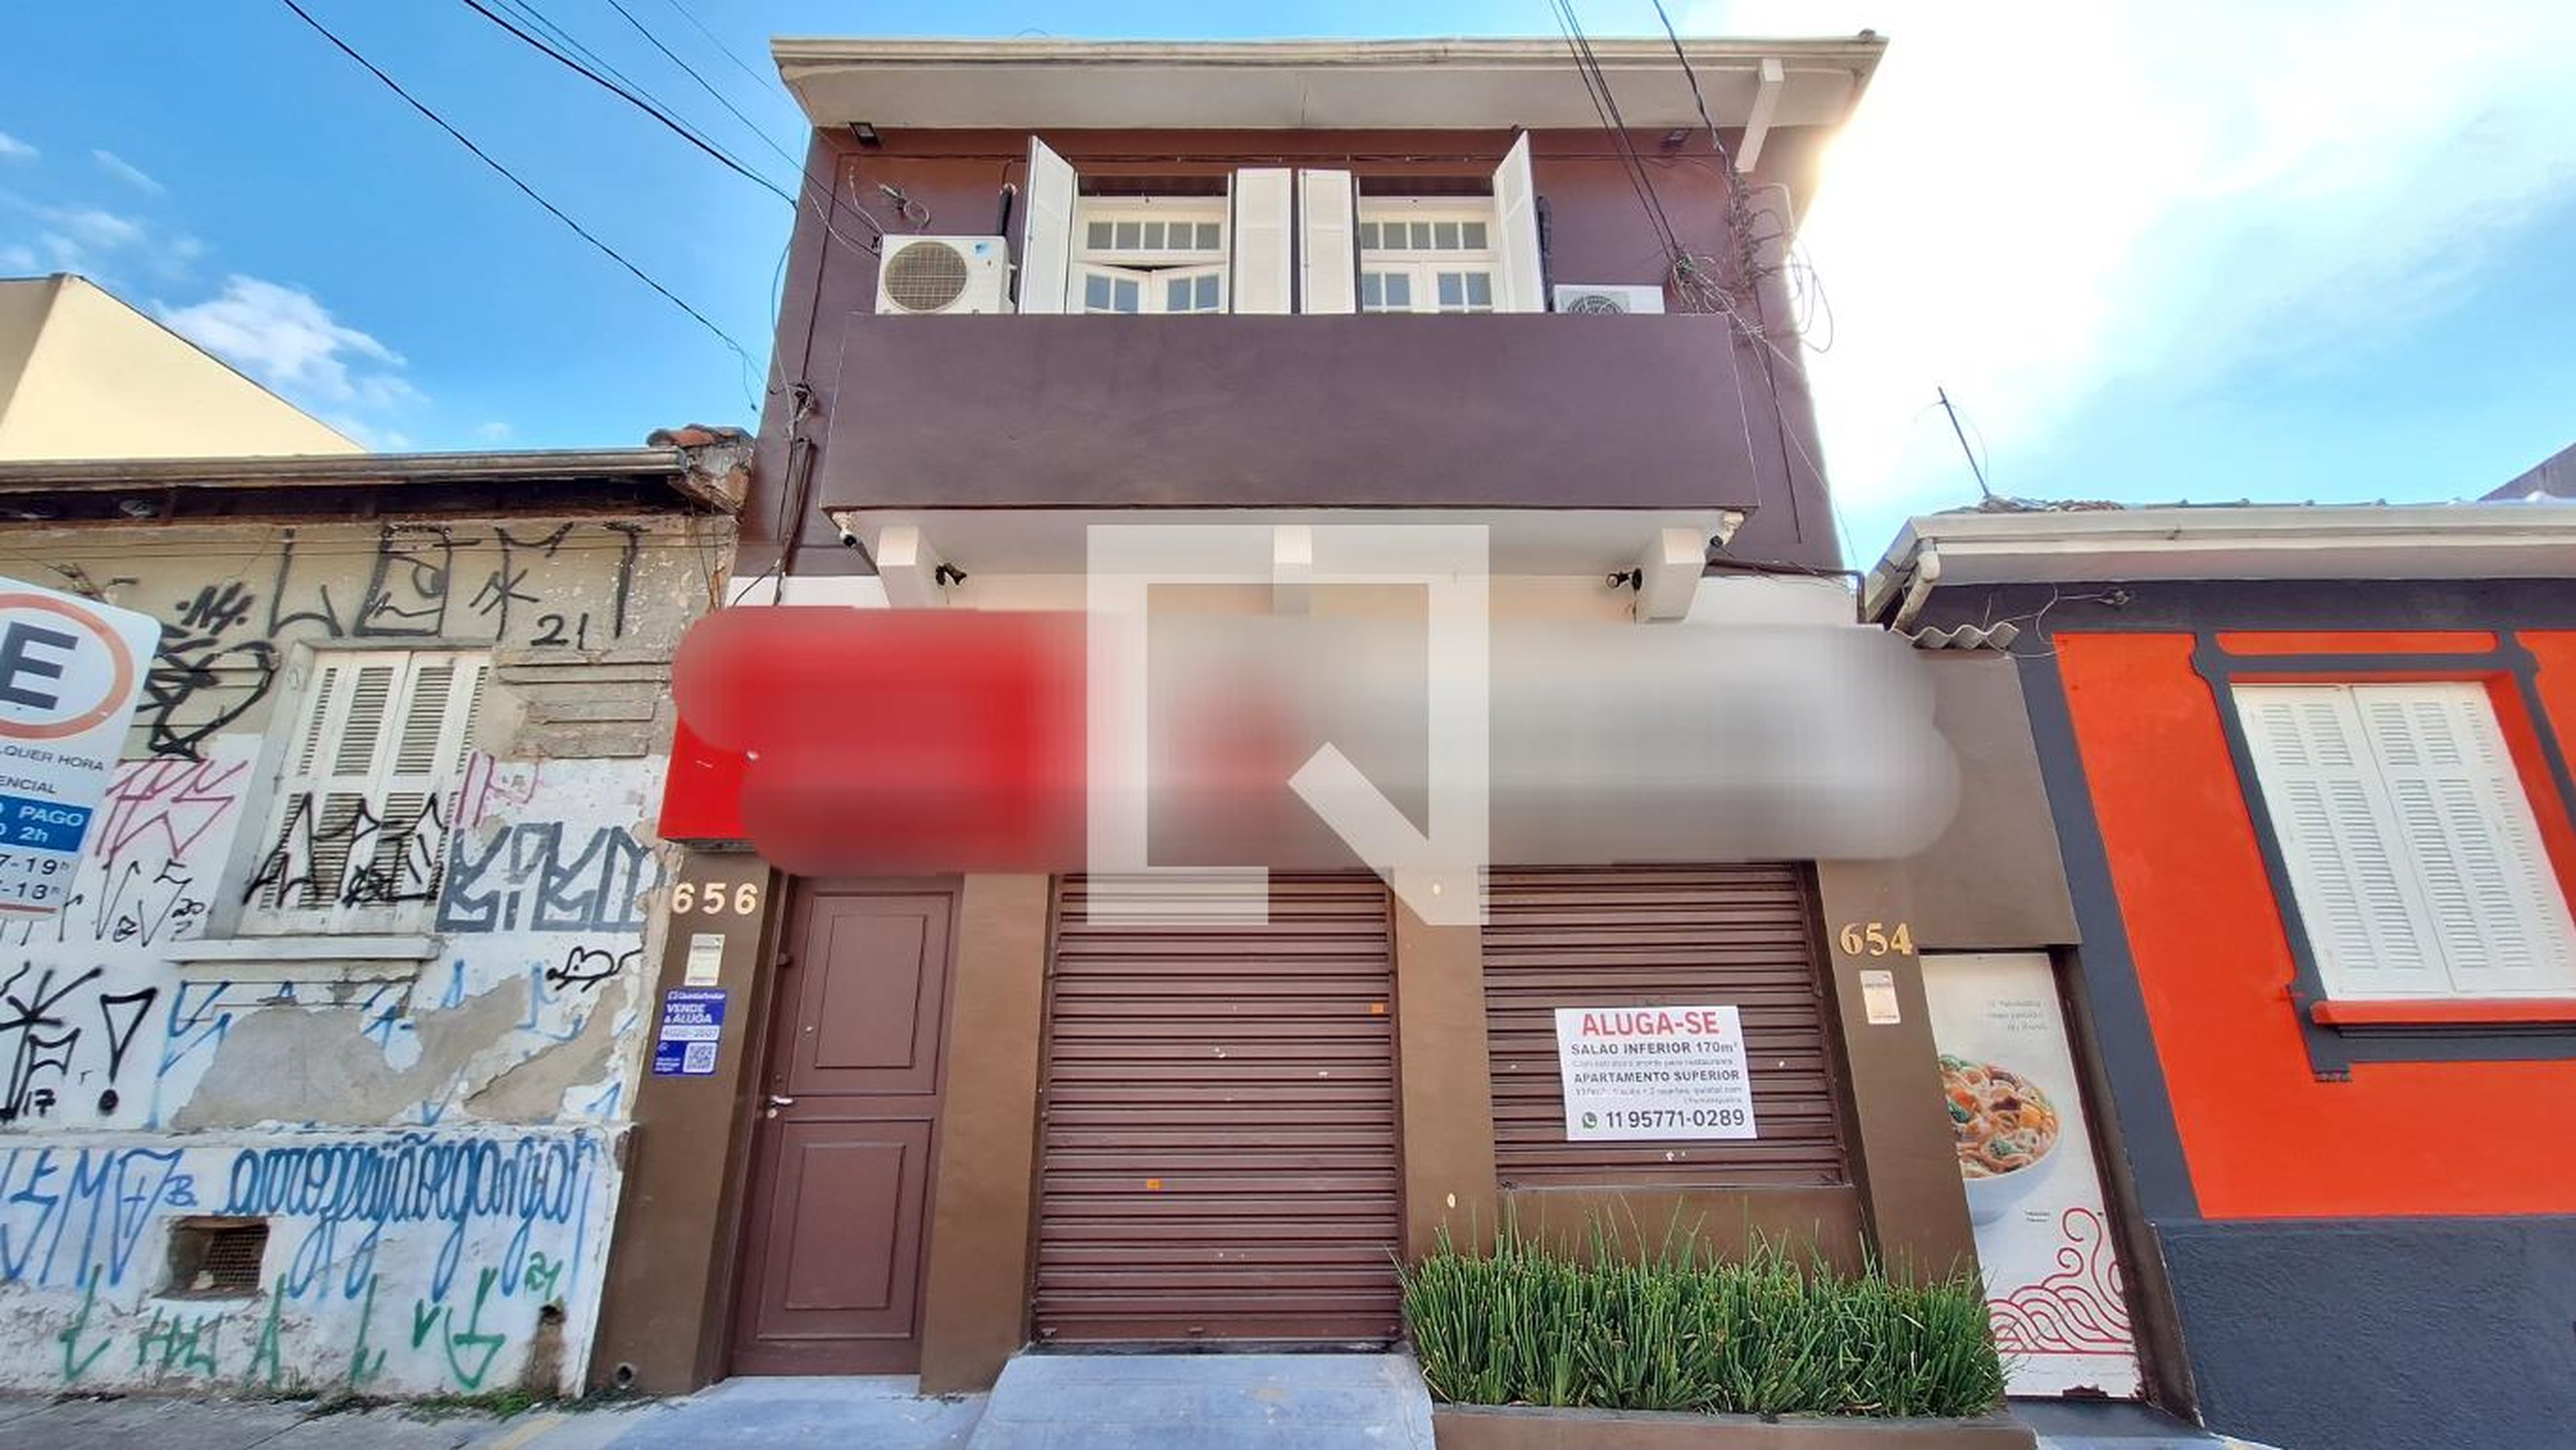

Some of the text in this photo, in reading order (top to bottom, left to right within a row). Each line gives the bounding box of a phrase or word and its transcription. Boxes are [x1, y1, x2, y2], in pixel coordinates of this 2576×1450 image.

[0, 621, 78, 710] E
[0, 745, 104, 771] QUER HORA
[18, 805, 84, 827] PAGO
[19, 826, 48, 842] 2h
[672, 882, 758, 915] 656
[1840, 922, 1912, 955] 654
[673, 1013, 712, 1024] ALUGA
[1582, 1012, 1720, 1036] ALUGA-SE
[1624, 1041, 1691, 1054] INFERIOR
[1574, 1070, 1739, 1083] APARTAMENTO SUPERIOR
[1606, 1109, 1745, 1128] 11 95771-0289
